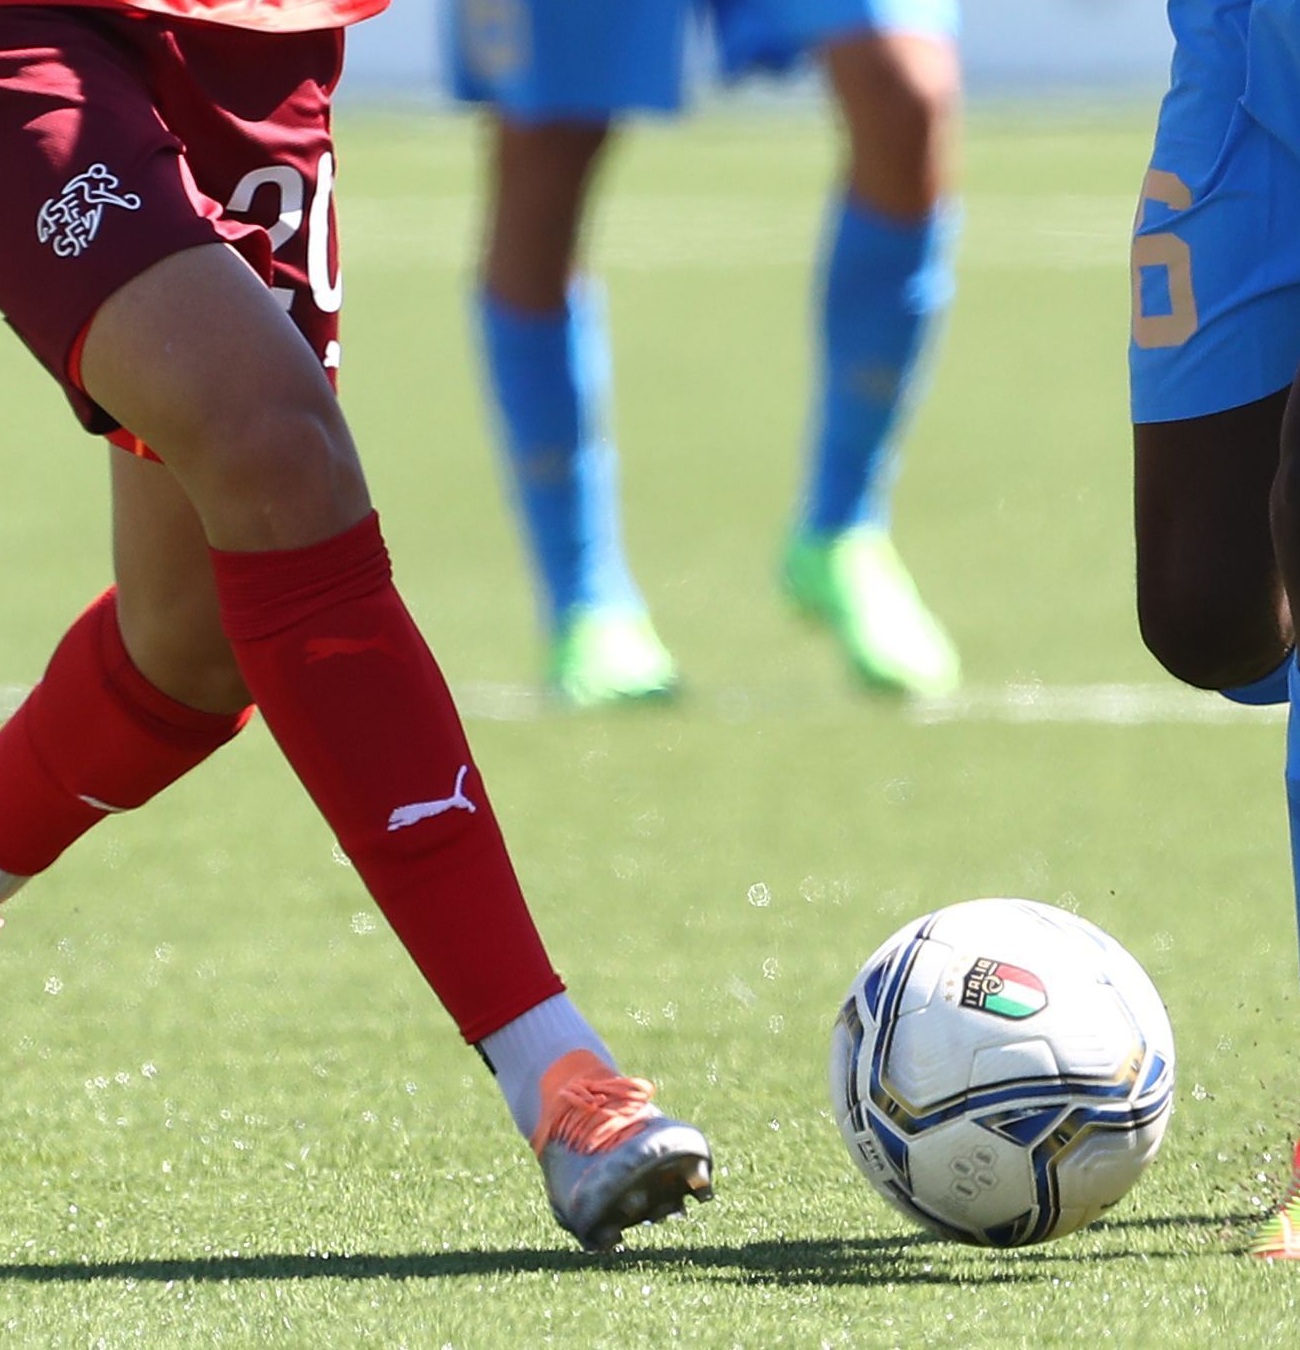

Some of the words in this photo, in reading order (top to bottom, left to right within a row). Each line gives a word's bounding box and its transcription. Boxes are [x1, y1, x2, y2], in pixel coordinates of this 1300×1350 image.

[226, 150, 342, 313] 20
[1131, 168, 1198, 348] 6
[965, 959, 993, 1006] ITALIA
